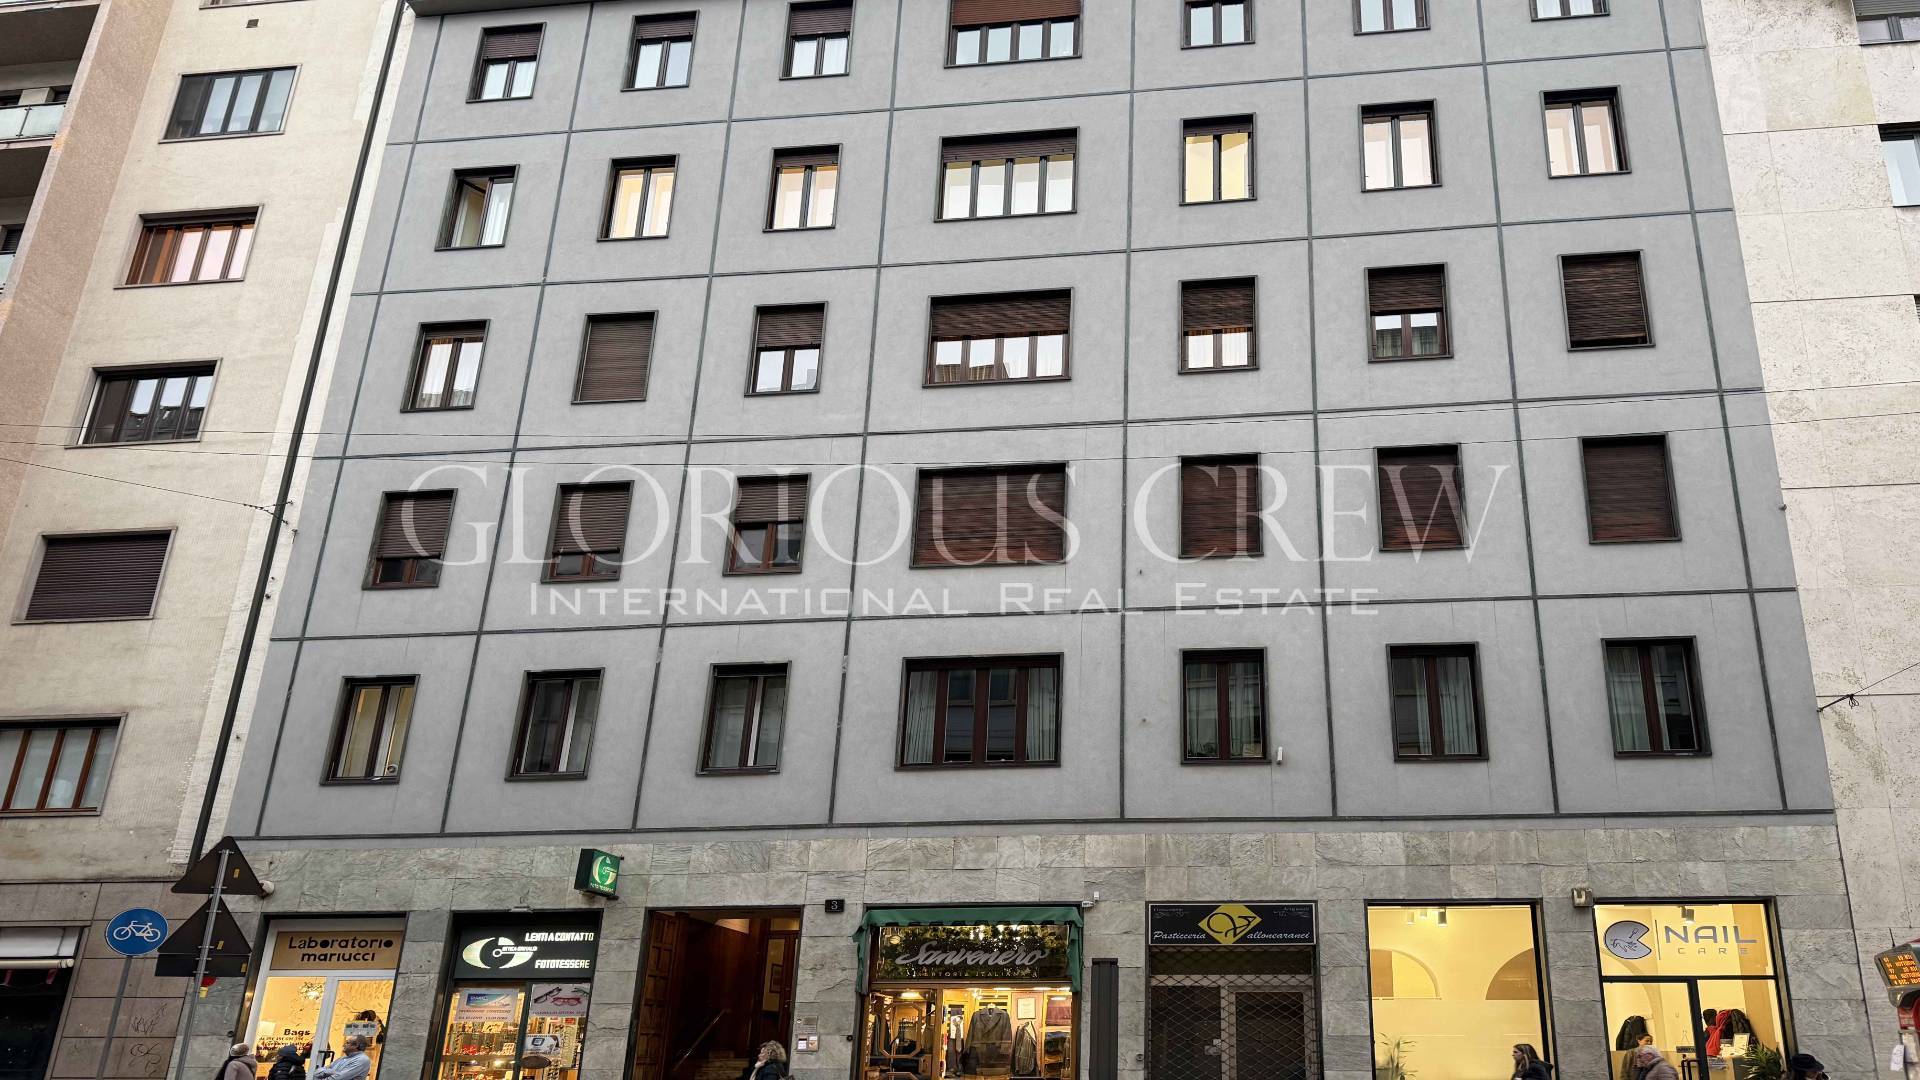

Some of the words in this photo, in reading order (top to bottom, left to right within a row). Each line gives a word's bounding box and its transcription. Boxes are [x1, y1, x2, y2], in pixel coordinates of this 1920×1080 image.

[555, 932, 595, 942] CONTATTO
[1153, 930, 1206, 940] Pasticceria
[1664, 925, 1757, 944] NAIL
[288, 936, 394, 949] Laboratorio
[895, 941, 1050, 965] Sanvenero
[1678, 947, 1748, 955] CARE
[535, 959, 590, 969] FOTOTESSERE
[283, 1028, 311, 1037] Bags
